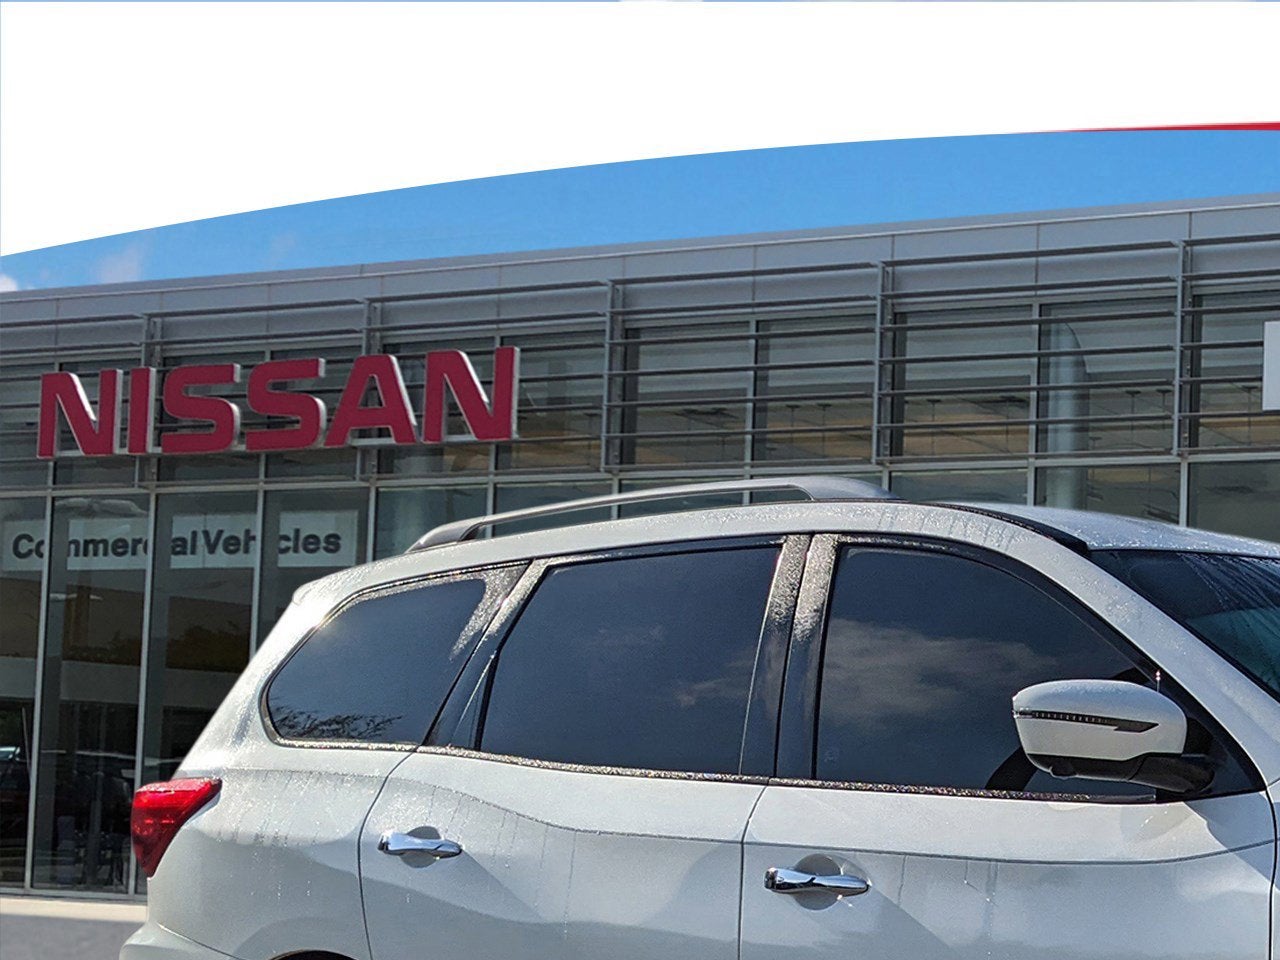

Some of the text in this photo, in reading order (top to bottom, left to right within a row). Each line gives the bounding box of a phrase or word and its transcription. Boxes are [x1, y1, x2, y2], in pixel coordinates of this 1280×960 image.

[37, 346, 519, 459] NISSAN
[12, 528, 341, 560] Cmeral Vehcles
